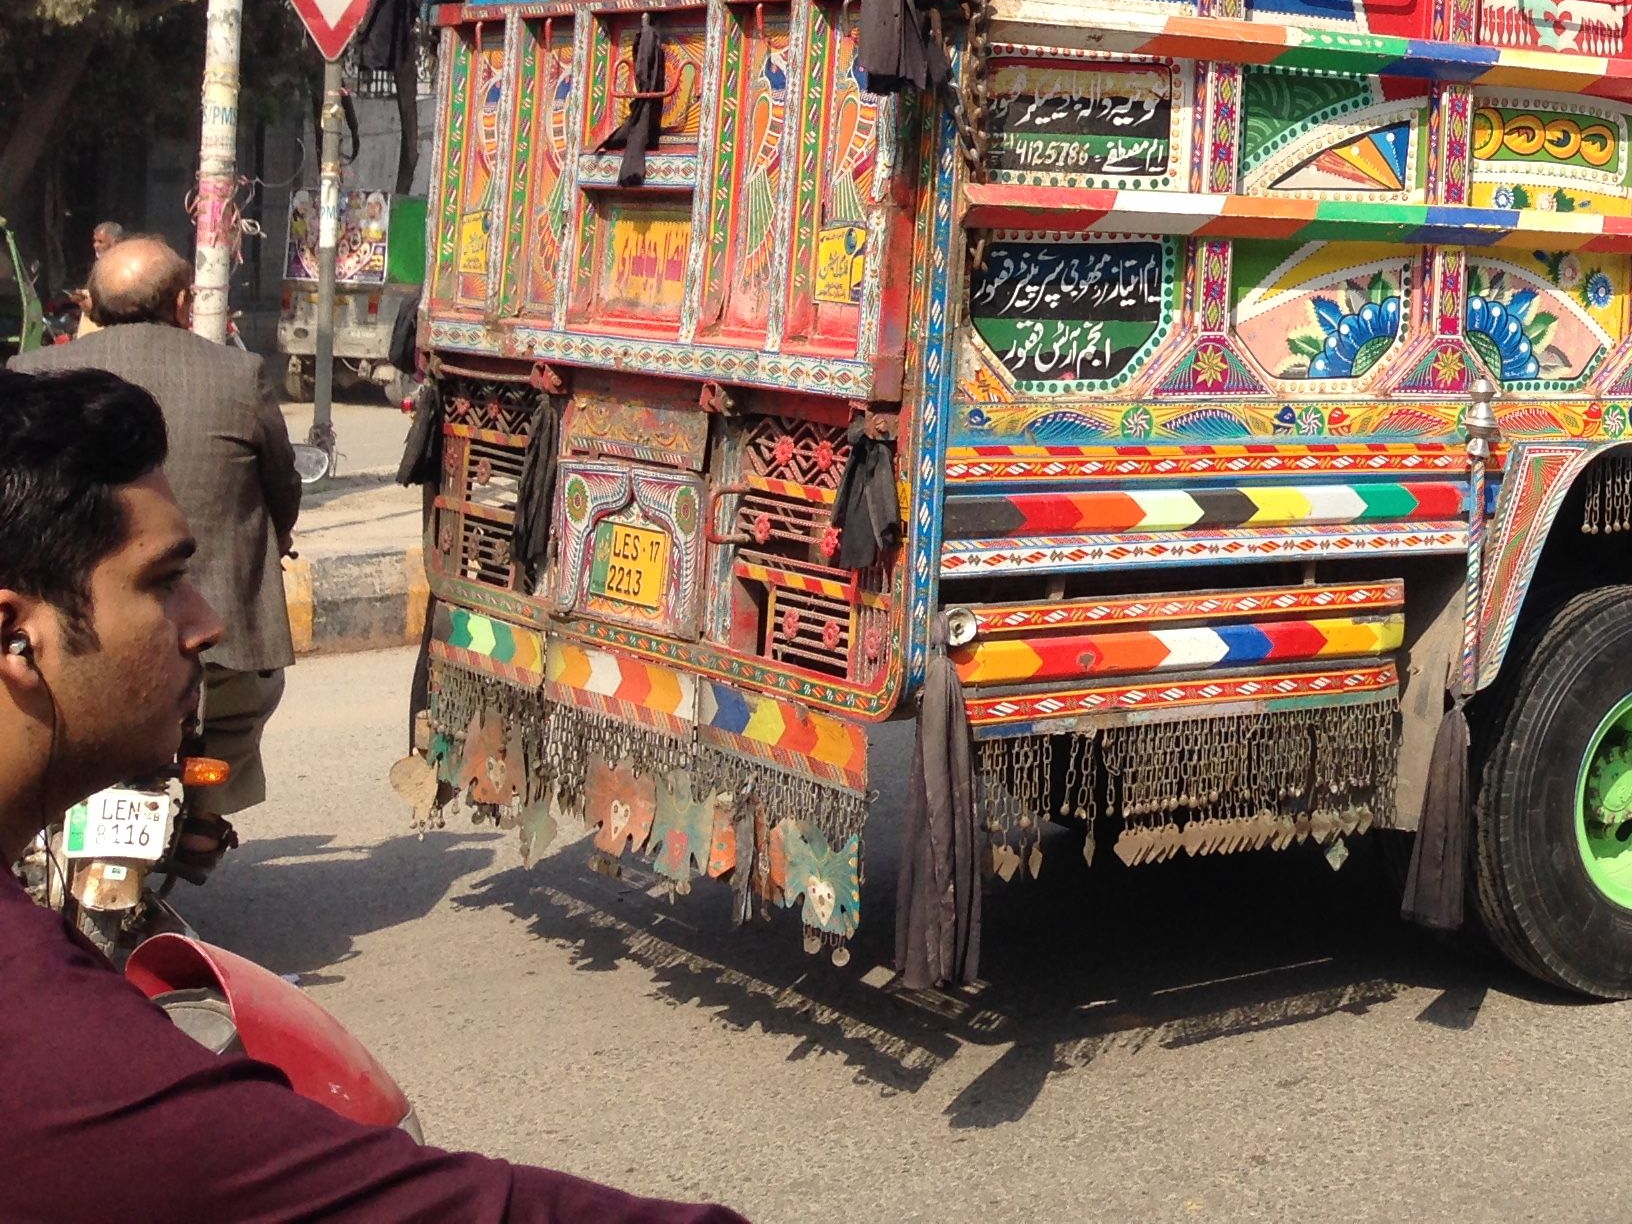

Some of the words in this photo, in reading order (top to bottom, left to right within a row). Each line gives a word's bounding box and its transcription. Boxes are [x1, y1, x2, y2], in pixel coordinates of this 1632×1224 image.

[613, 530, 640, 561] LES
[649, 540, 661, 563] 17
[607, 564, 642, 596] 2213
[102, 798, 141, 821] LEN
